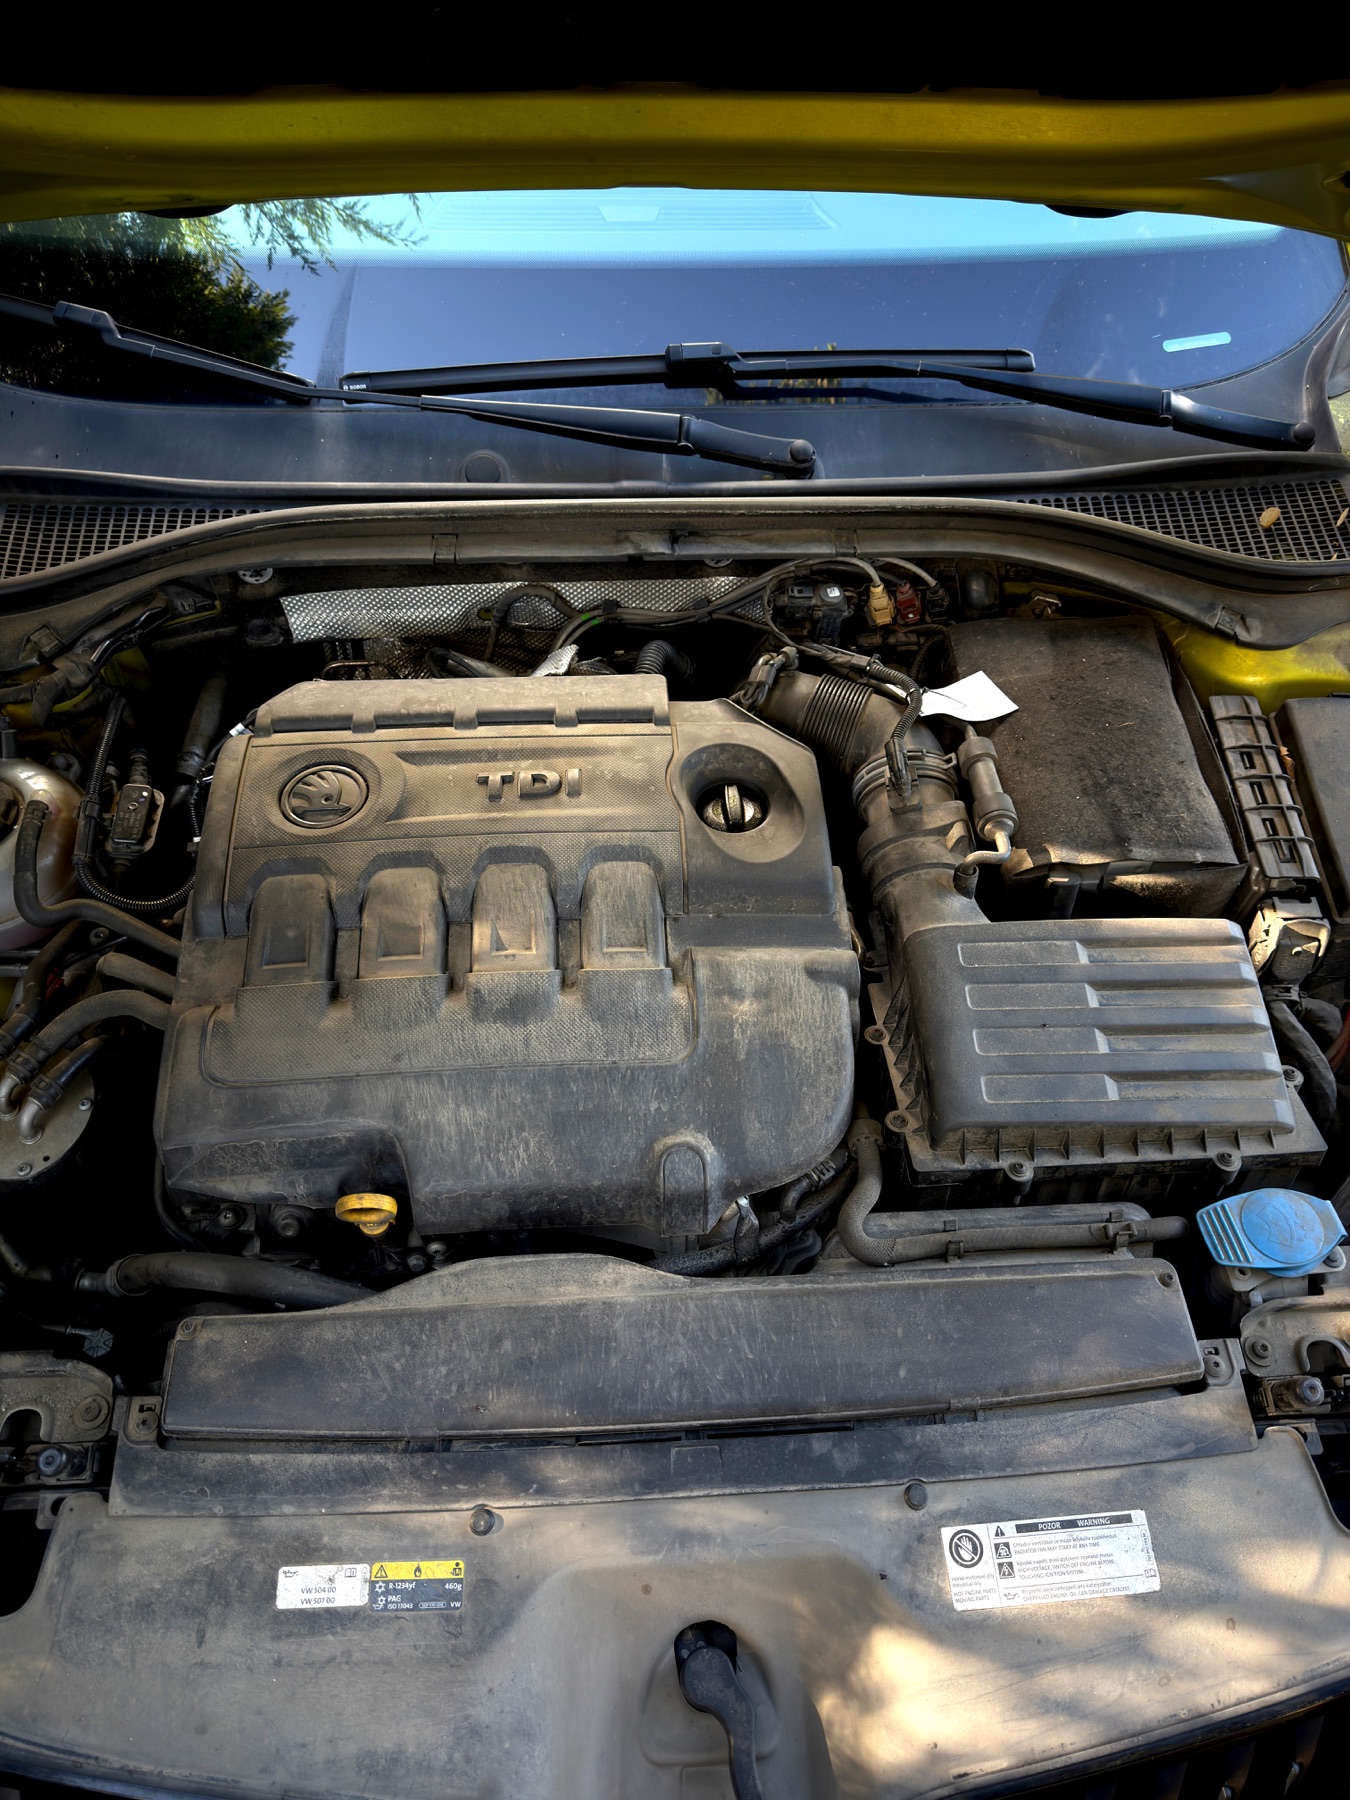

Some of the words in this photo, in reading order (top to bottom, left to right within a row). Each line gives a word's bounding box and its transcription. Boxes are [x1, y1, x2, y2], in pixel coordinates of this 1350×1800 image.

[476, 768, 582, 802] TDI
[1038, 1522, 1061, 1530] POZOR
[1077, 1518, 1110, 1526] WARNING
[388, 1582, 416, 1590] R-1234yf
[444, 1582, 462, 1591] 460g
